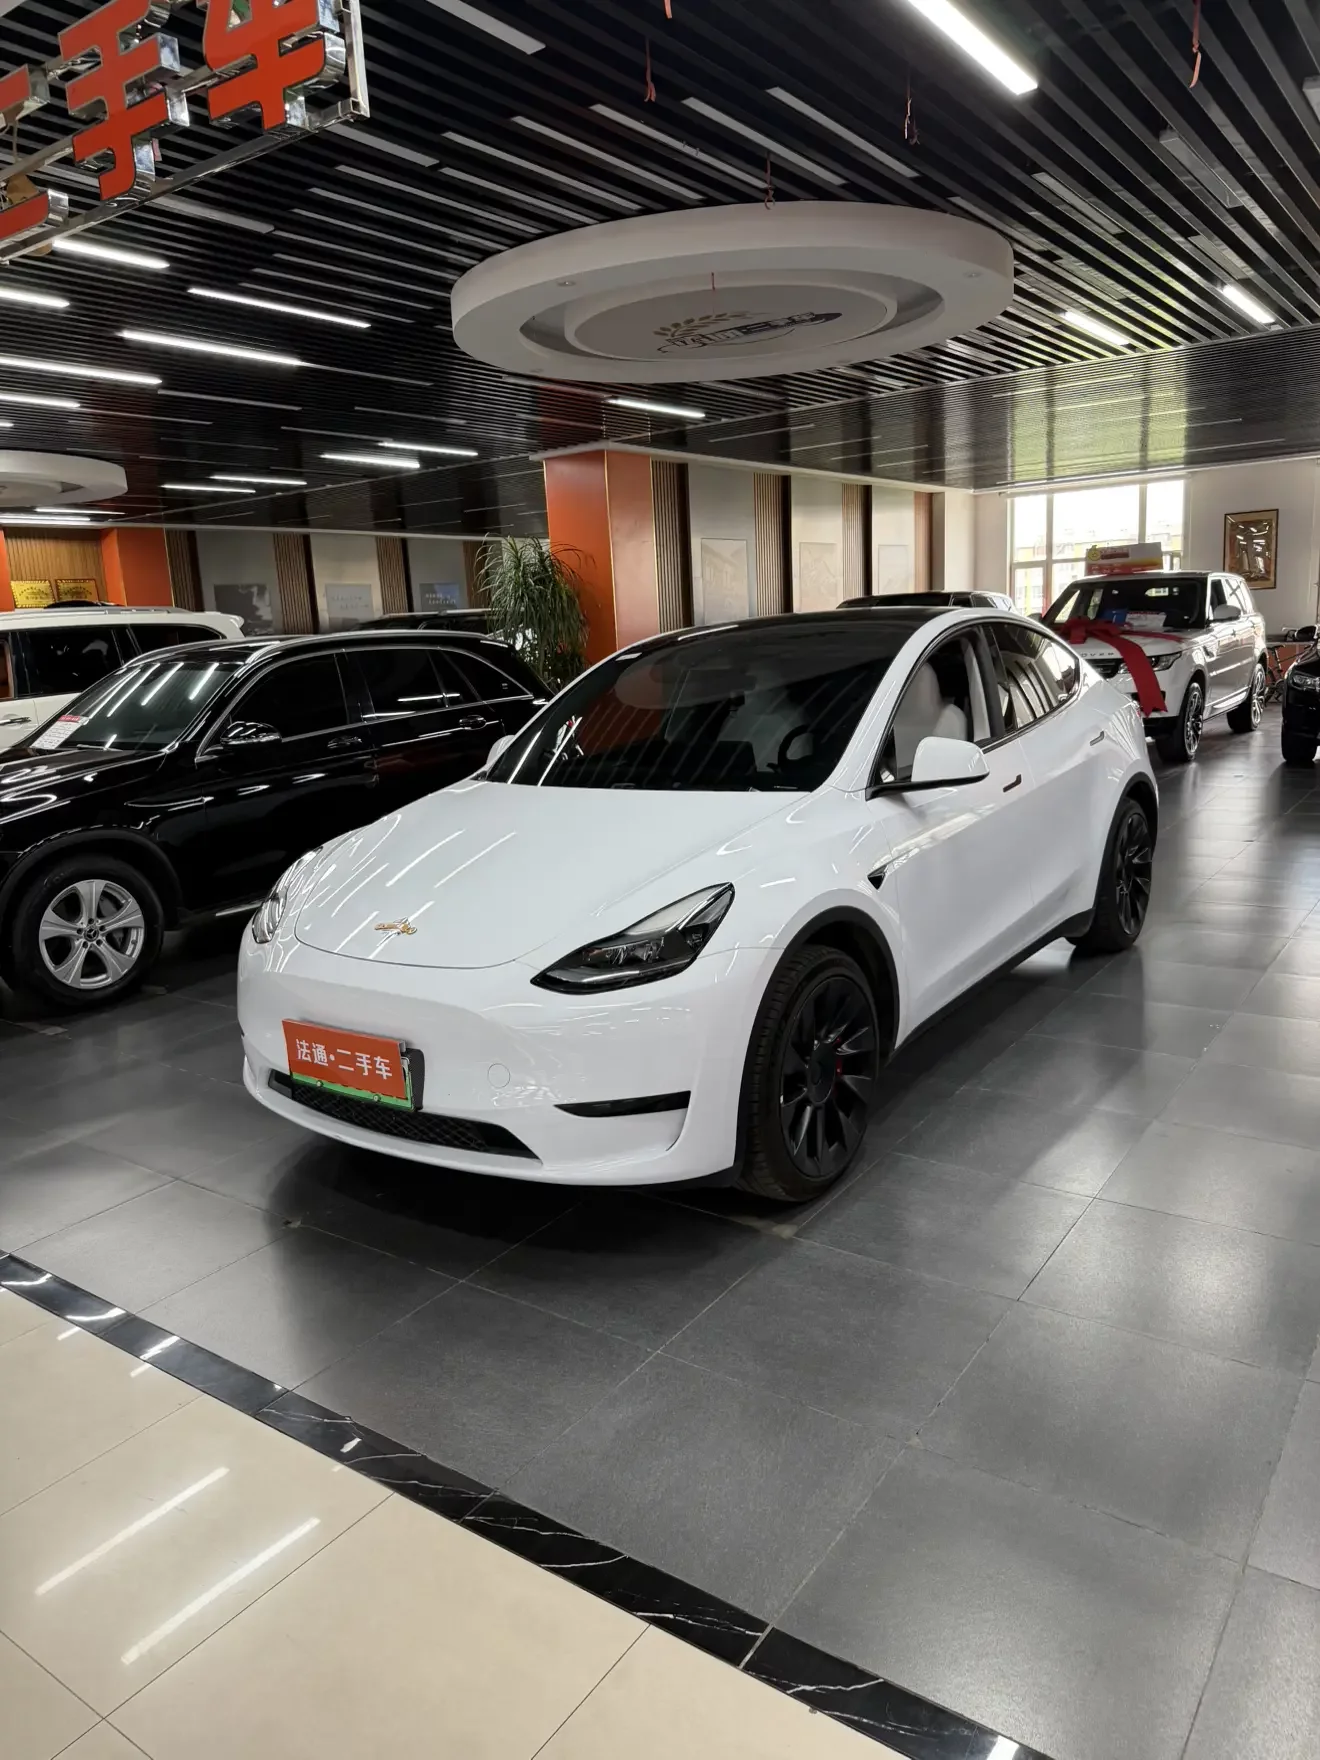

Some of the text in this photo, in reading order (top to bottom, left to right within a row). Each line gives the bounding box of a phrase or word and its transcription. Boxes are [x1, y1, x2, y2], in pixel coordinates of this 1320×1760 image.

[296, 1038, 393, 1080] 法通·二手车
